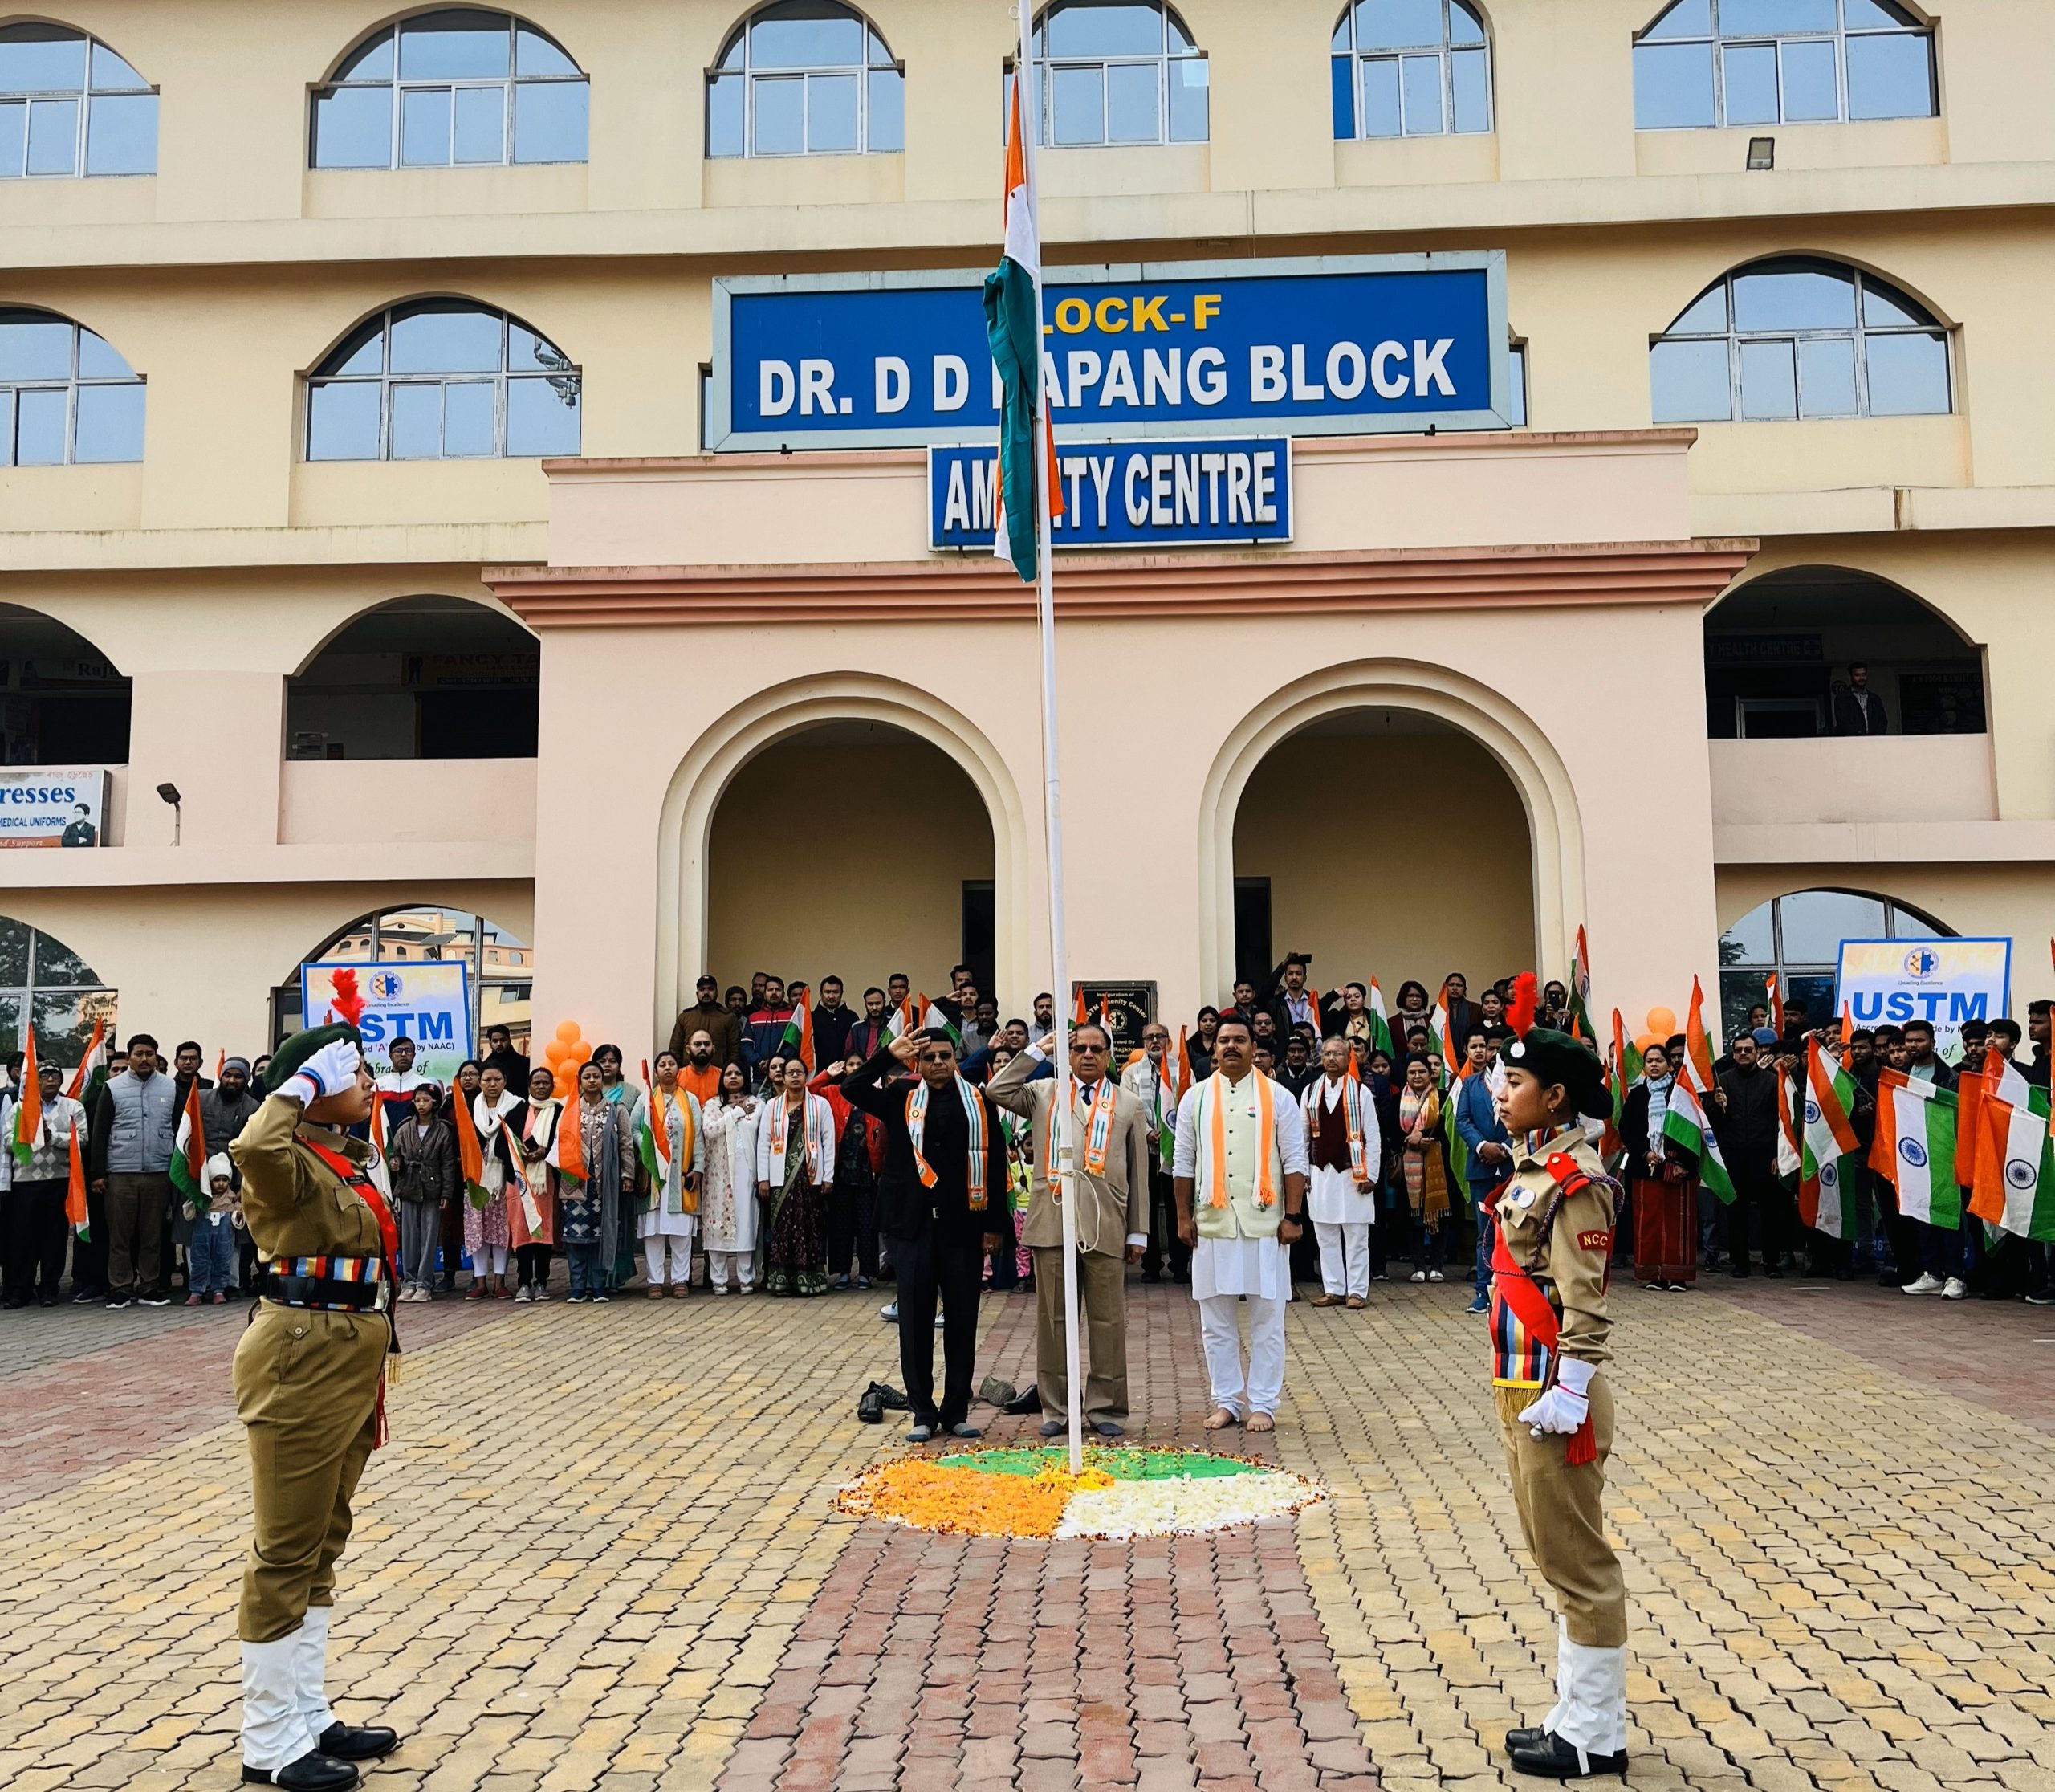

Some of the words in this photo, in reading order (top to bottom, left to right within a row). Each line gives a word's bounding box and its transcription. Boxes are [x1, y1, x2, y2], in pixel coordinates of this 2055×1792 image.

[1042, 294, 1223, 335] OCK-F
[759, 359, 853, 417] DR.
[875, 356, 911, 413] D
[933, 353, 970, 411] D
[1251, 338, 1457, 403] BLOCK
[943, 455, 1116, 531] AMTY
[1125, 450, 1278, 528] CENTRE
[434, 654, 502, 666] FANCY
[30, 817, 67, 826] UNIFORMS
[1853, 992, 1988, 1022] USTM
[360, 1012, 454, 1043] STM
[1945, 1025, 1955, 1034] by
[417, 1044, 425, 1052] by
[428, 1043, 454, 1051] NAAC)
[1943, 1044, 1957, 1059] of
[417, 1061, 429, 1076] of
[1582, 1233, 1609, 1247] NCC
